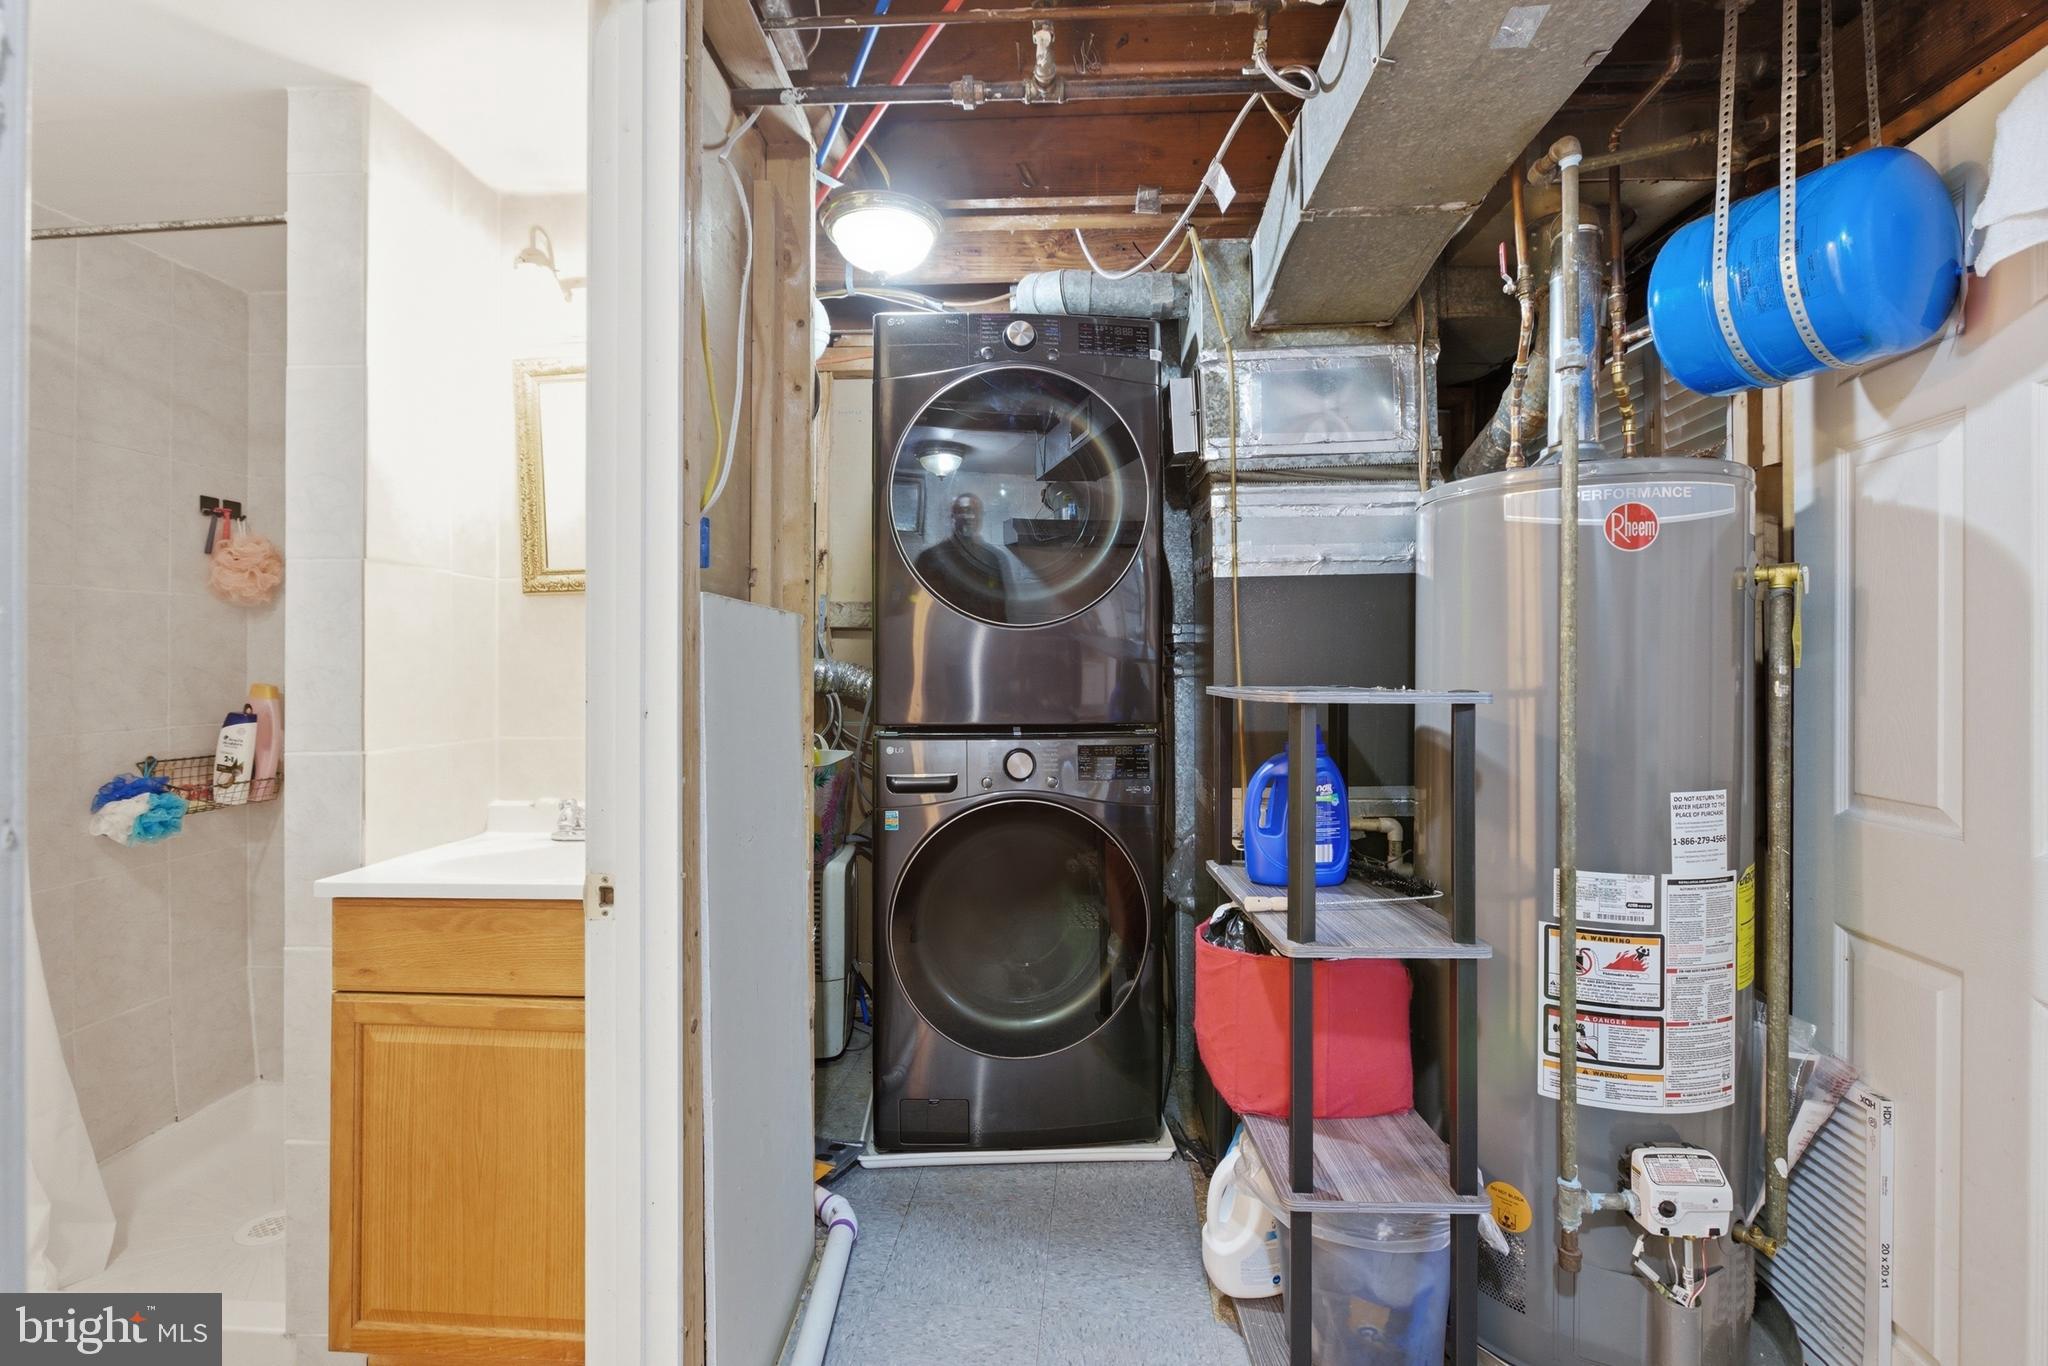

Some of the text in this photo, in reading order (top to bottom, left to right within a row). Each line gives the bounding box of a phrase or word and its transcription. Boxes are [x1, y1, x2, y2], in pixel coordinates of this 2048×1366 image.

[1577, 486, 1692, 501] ERFORMANCE
[1611, 504, 1656, 543] Rheem
[1692, 802, 1710, 810] HEATER
[1590, 936, 1631, 944] WARNING
[1592, 1017, 1627, 1025] DANGER
[1593, 1070, 1628, 1080] WARNING
[1883, 1106, 1892, 1126] HDX
[1881, 1243, 1890, 1255] 20
[1881, 1264, 1890, 1277] 20
